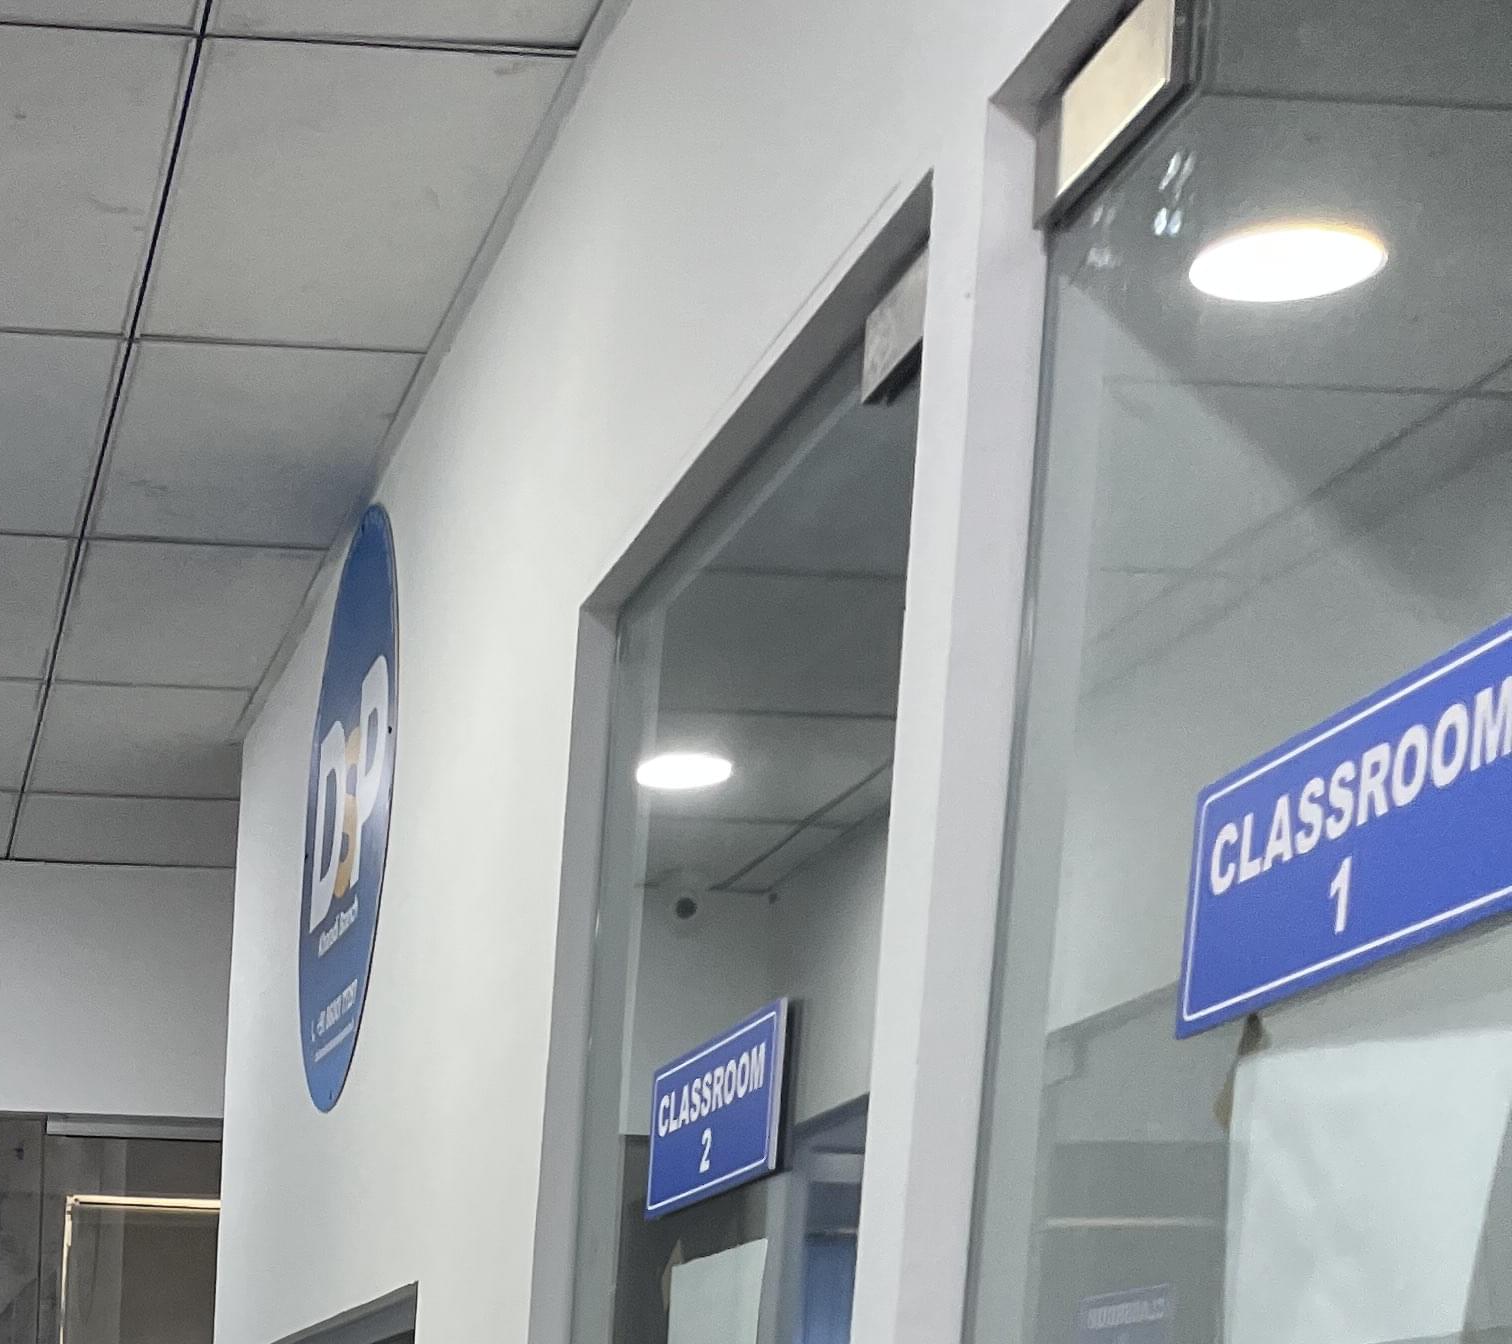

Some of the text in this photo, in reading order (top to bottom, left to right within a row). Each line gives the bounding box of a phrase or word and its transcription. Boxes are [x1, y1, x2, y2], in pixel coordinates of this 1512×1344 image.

[1209, 676, 1512, 896] CLASSROOM
[1329, 855, 1353, 936] 1
[658, 1040, 767, 1138] CLASSROOM
[699, 1127, 713, 1174] 2
